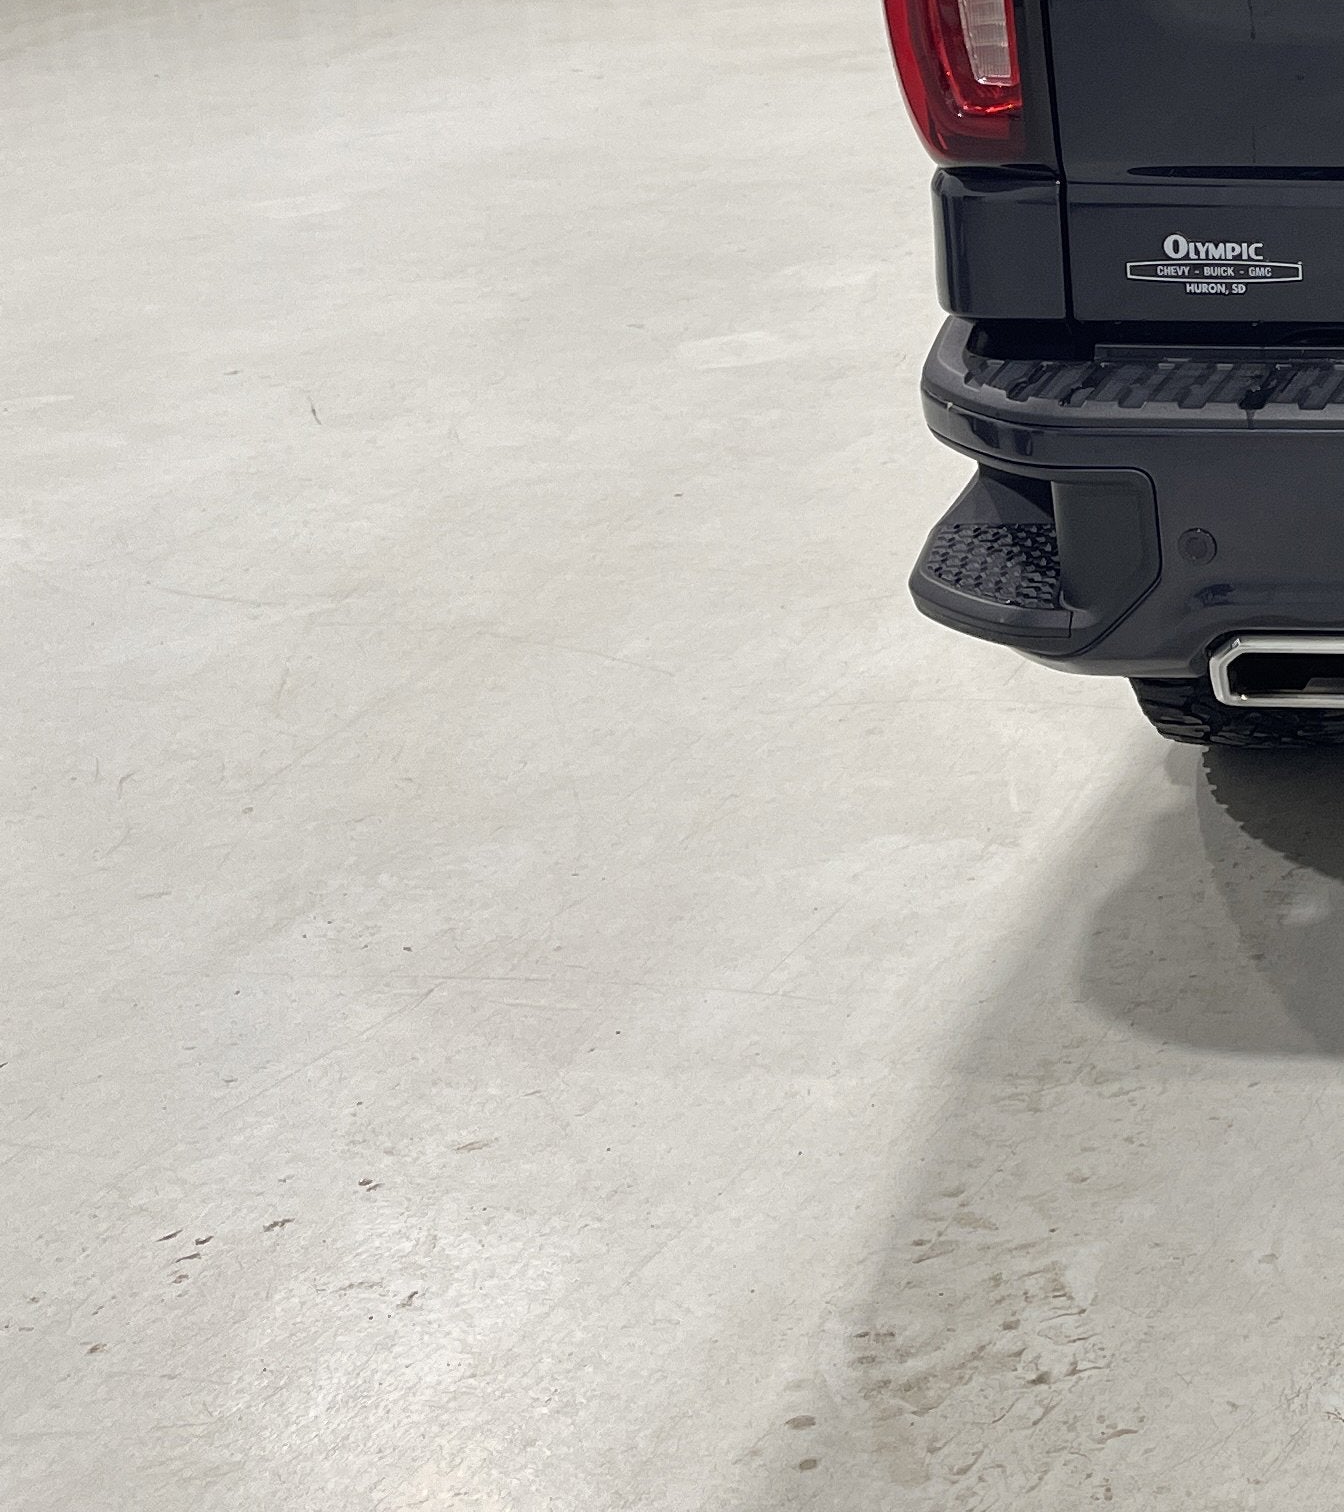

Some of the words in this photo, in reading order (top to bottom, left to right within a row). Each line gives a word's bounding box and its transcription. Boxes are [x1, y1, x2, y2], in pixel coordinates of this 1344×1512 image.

[1157, 266, 1190, 276] CHEVY
[1203, 266, 1235, 277] BUICK
[1249, 267, 1272, 277] GMC
[1186, 283, 1229, 294] HURON,
[1231, 283, 1246, 294] SD
